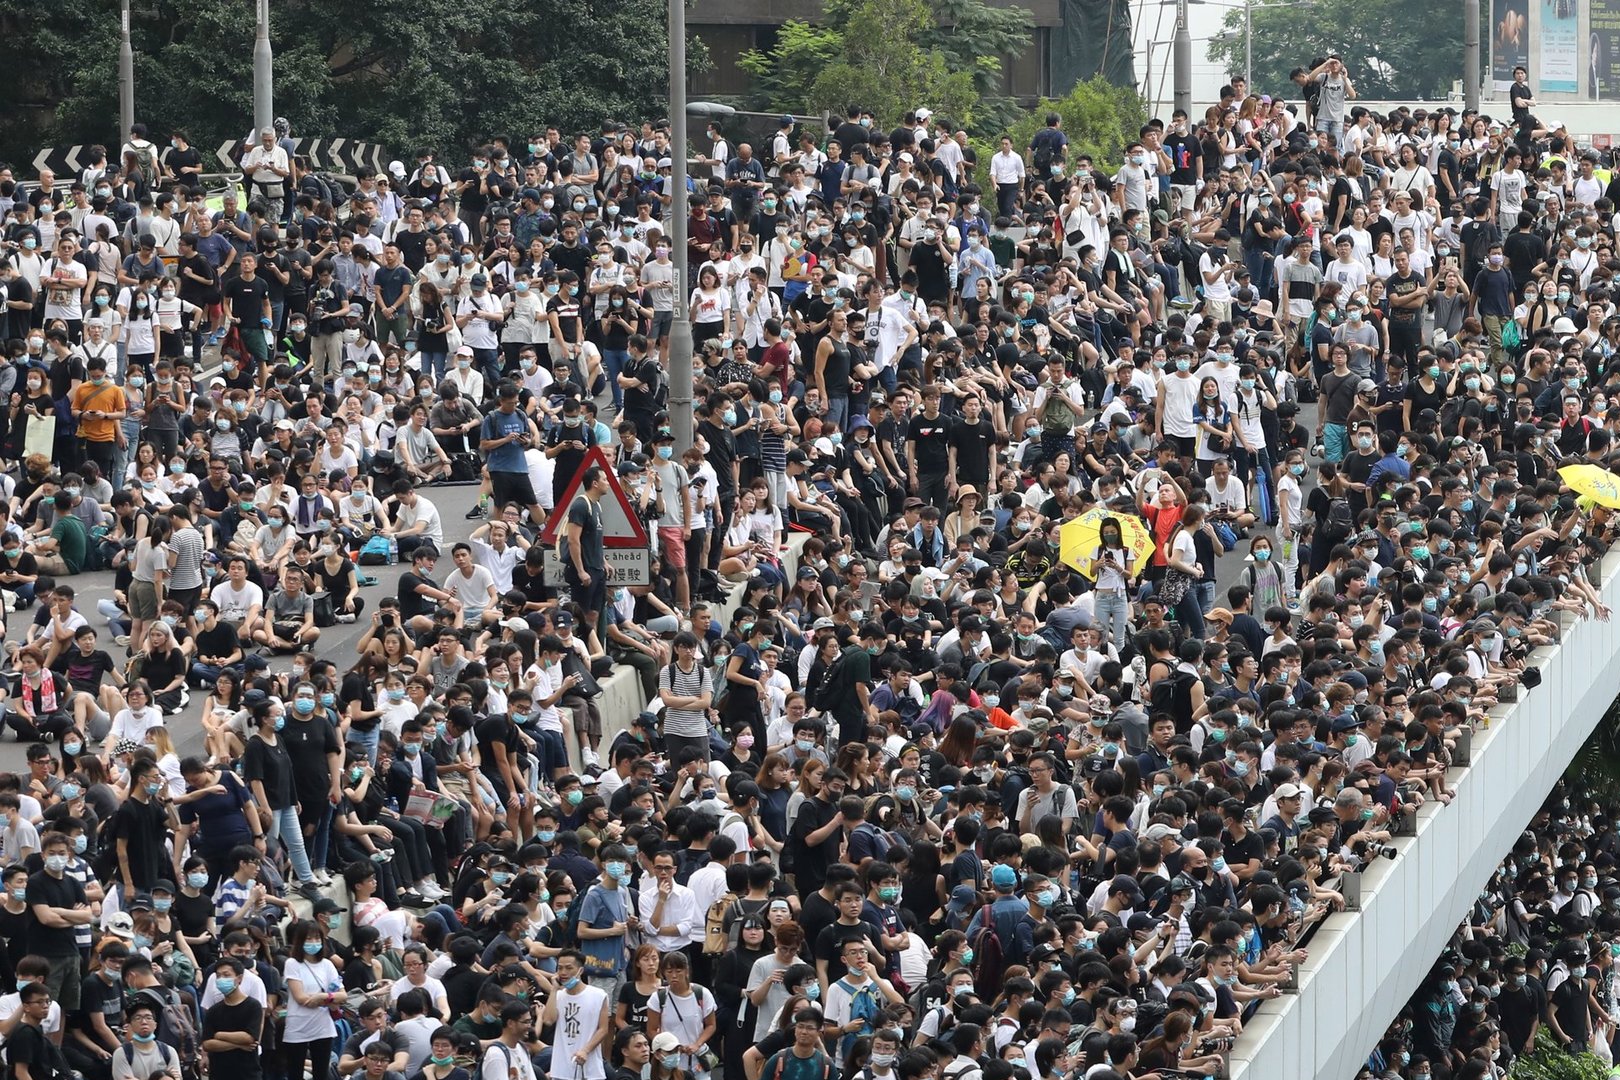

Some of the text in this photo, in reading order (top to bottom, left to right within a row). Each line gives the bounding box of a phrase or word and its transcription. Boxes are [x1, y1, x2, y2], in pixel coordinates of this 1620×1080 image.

[1352, 421, 1358, 431] 3
[553, 568, 641, 581] 小慢駛
[926, 997, 941, 1010] 54
